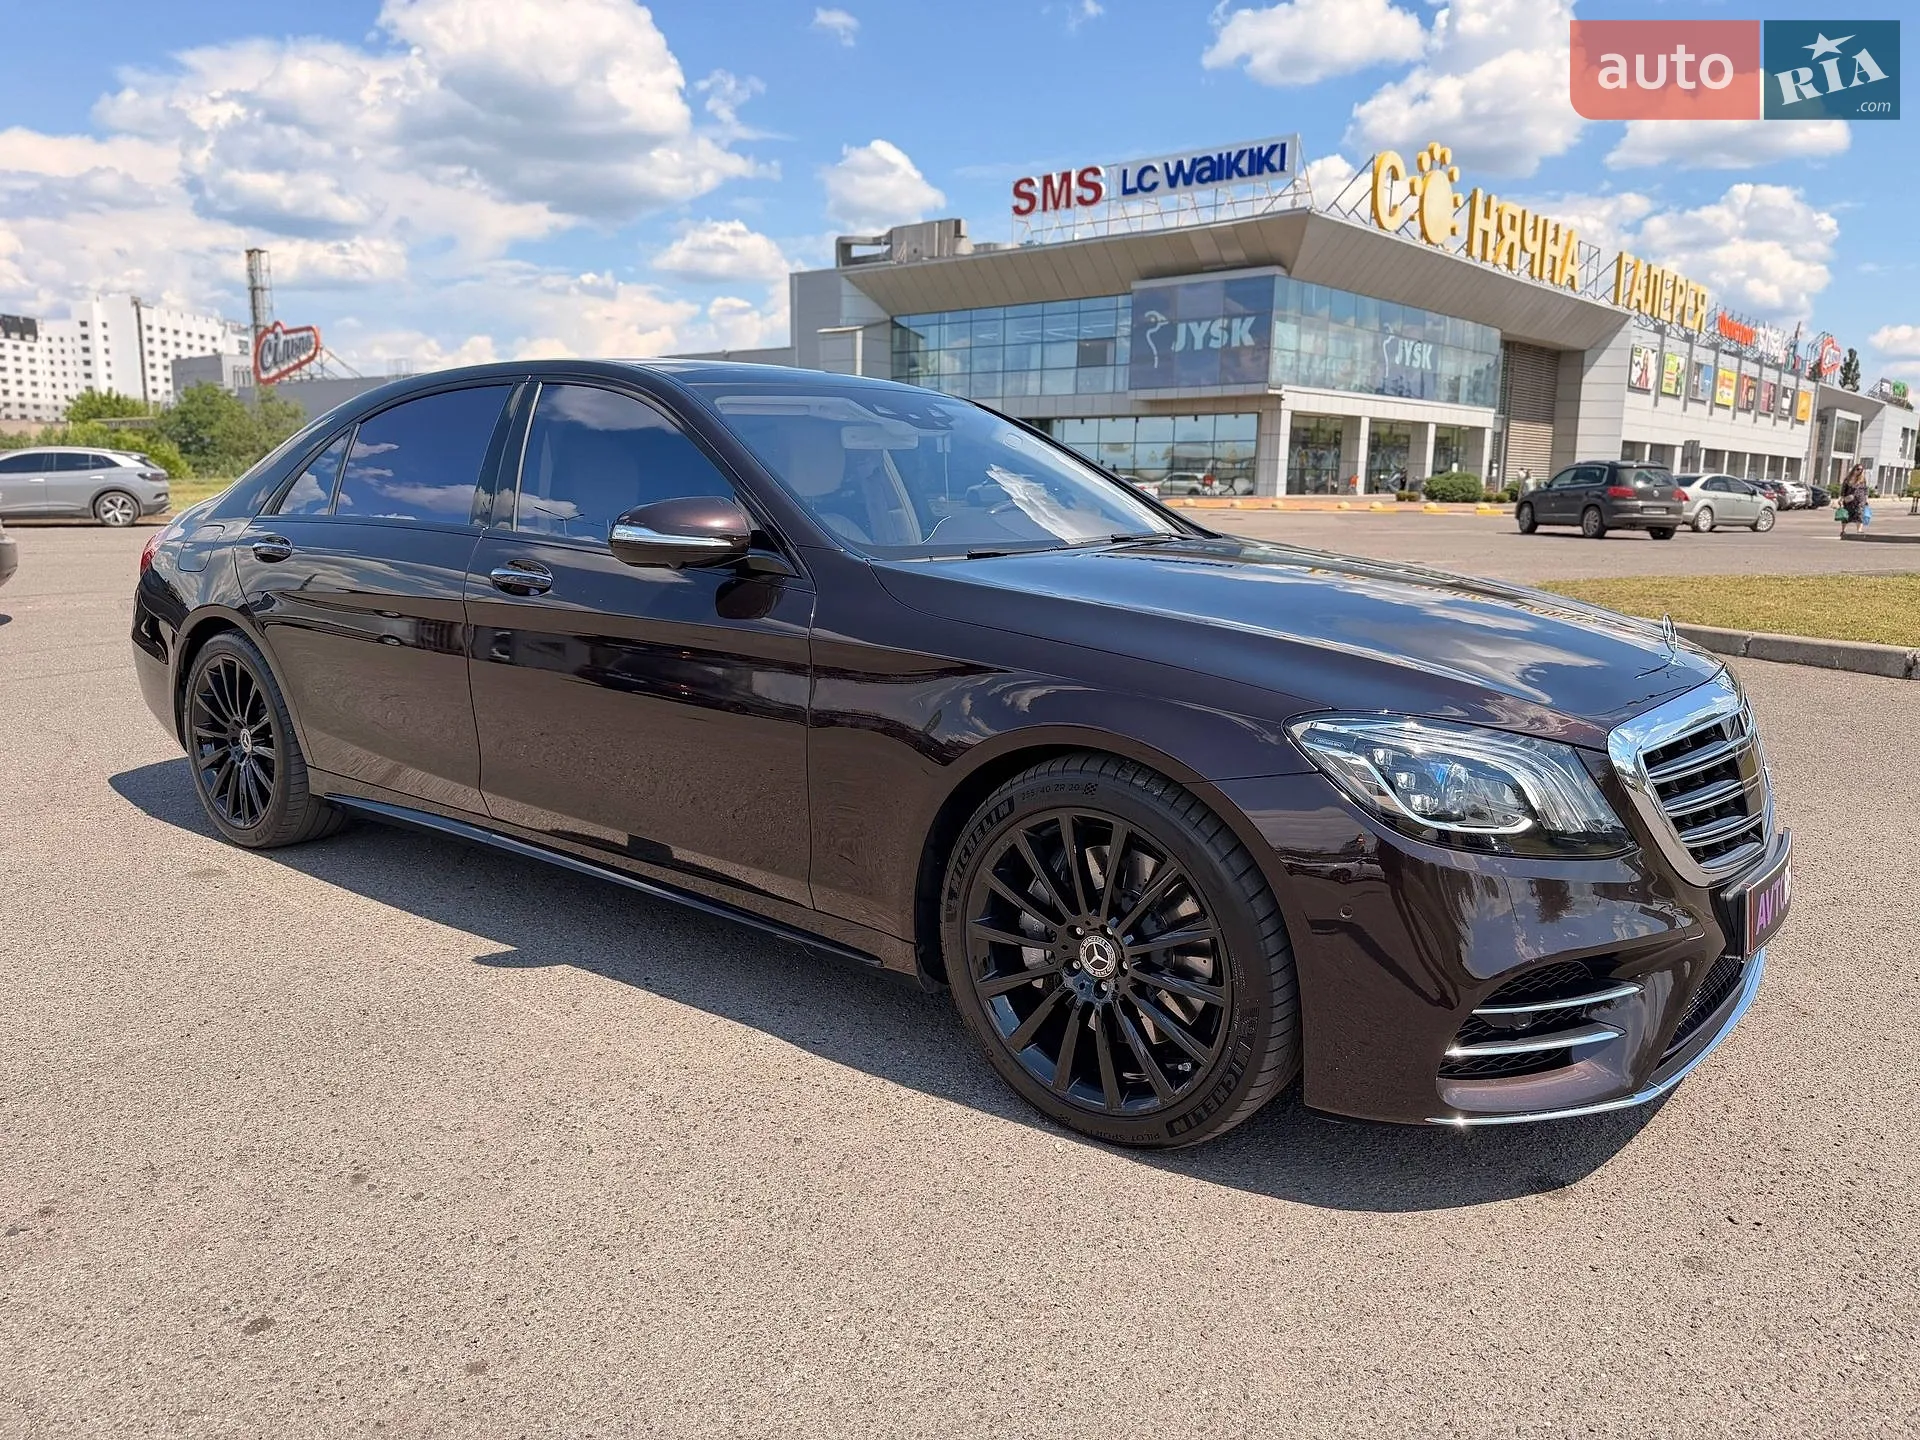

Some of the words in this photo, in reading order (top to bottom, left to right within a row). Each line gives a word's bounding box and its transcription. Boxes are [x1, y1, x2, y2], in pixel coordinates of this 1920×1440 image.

[1012, 166, 1105, 216] SMS
[1121, 165, 1159, 196] LC
[1171, 316, 1256, 352] JYSK
[1394, 338, 1433, 370] JYSK
